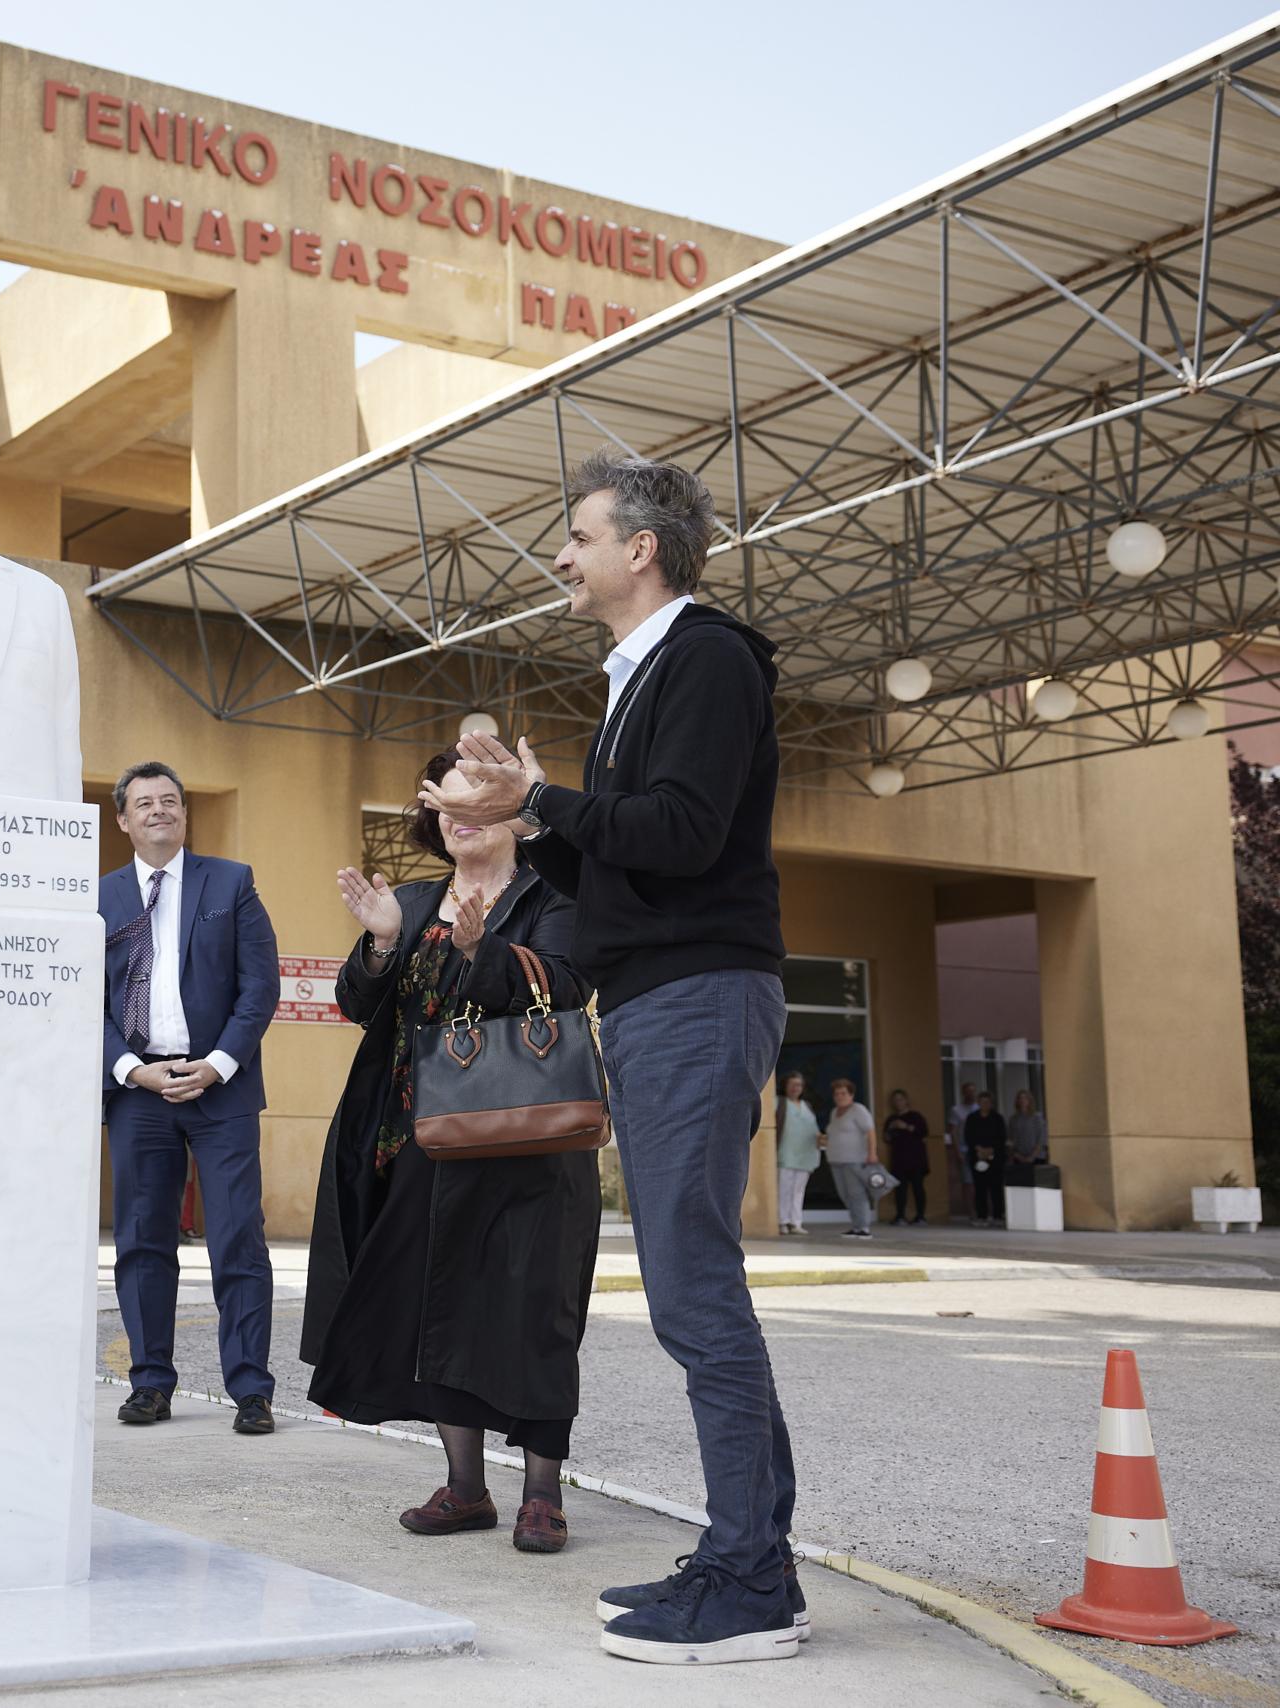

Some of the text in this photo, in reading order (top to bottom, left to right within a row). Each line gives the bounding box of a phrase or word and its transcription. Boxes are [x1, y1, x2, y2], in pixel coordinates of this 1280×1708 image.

[42, 80, 708, 290] ΓΕΝΙΚΟ ΝΟΣΟΚΟΜΕΙΟ
[48, 965, 83, 983] ΤΟΥ
